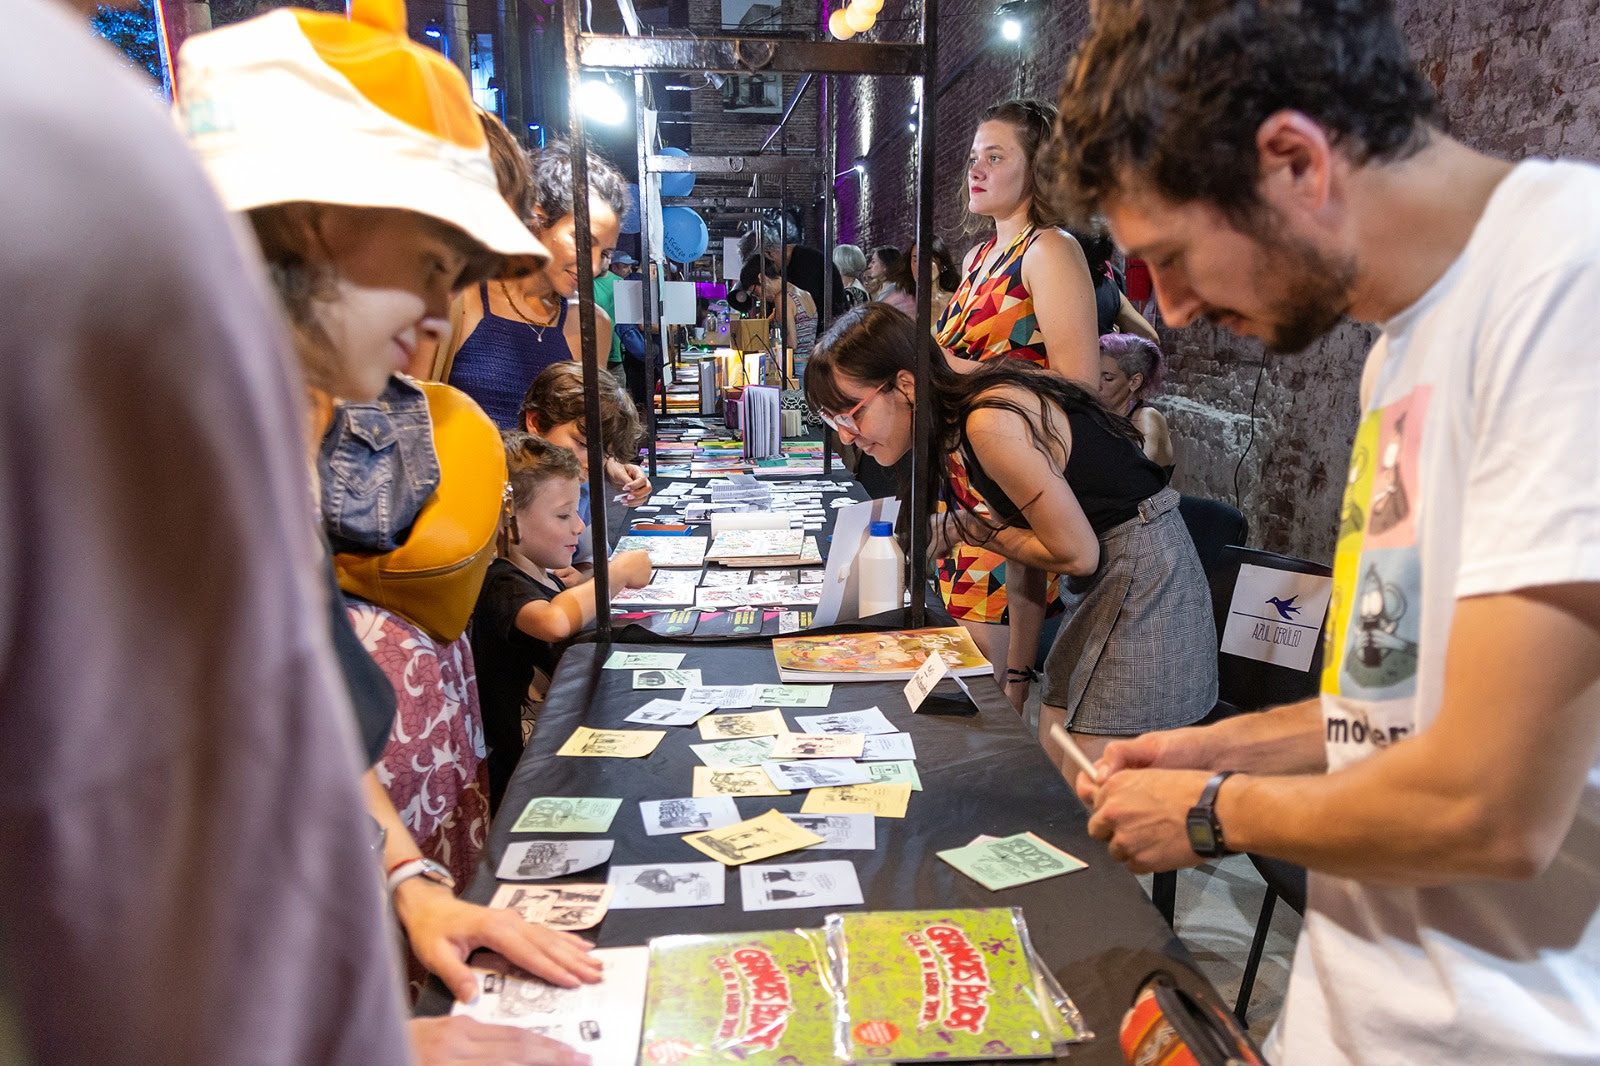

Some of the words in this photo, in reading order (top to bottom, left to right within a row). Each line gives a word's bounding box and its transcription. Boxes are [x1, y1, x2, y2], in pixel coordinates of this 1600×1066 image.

[1251, 622, 1271, 643] AZUL
[1273, 626, 1302, 648] CERÚLEO
[1327, 713, 1414, 750] moer
